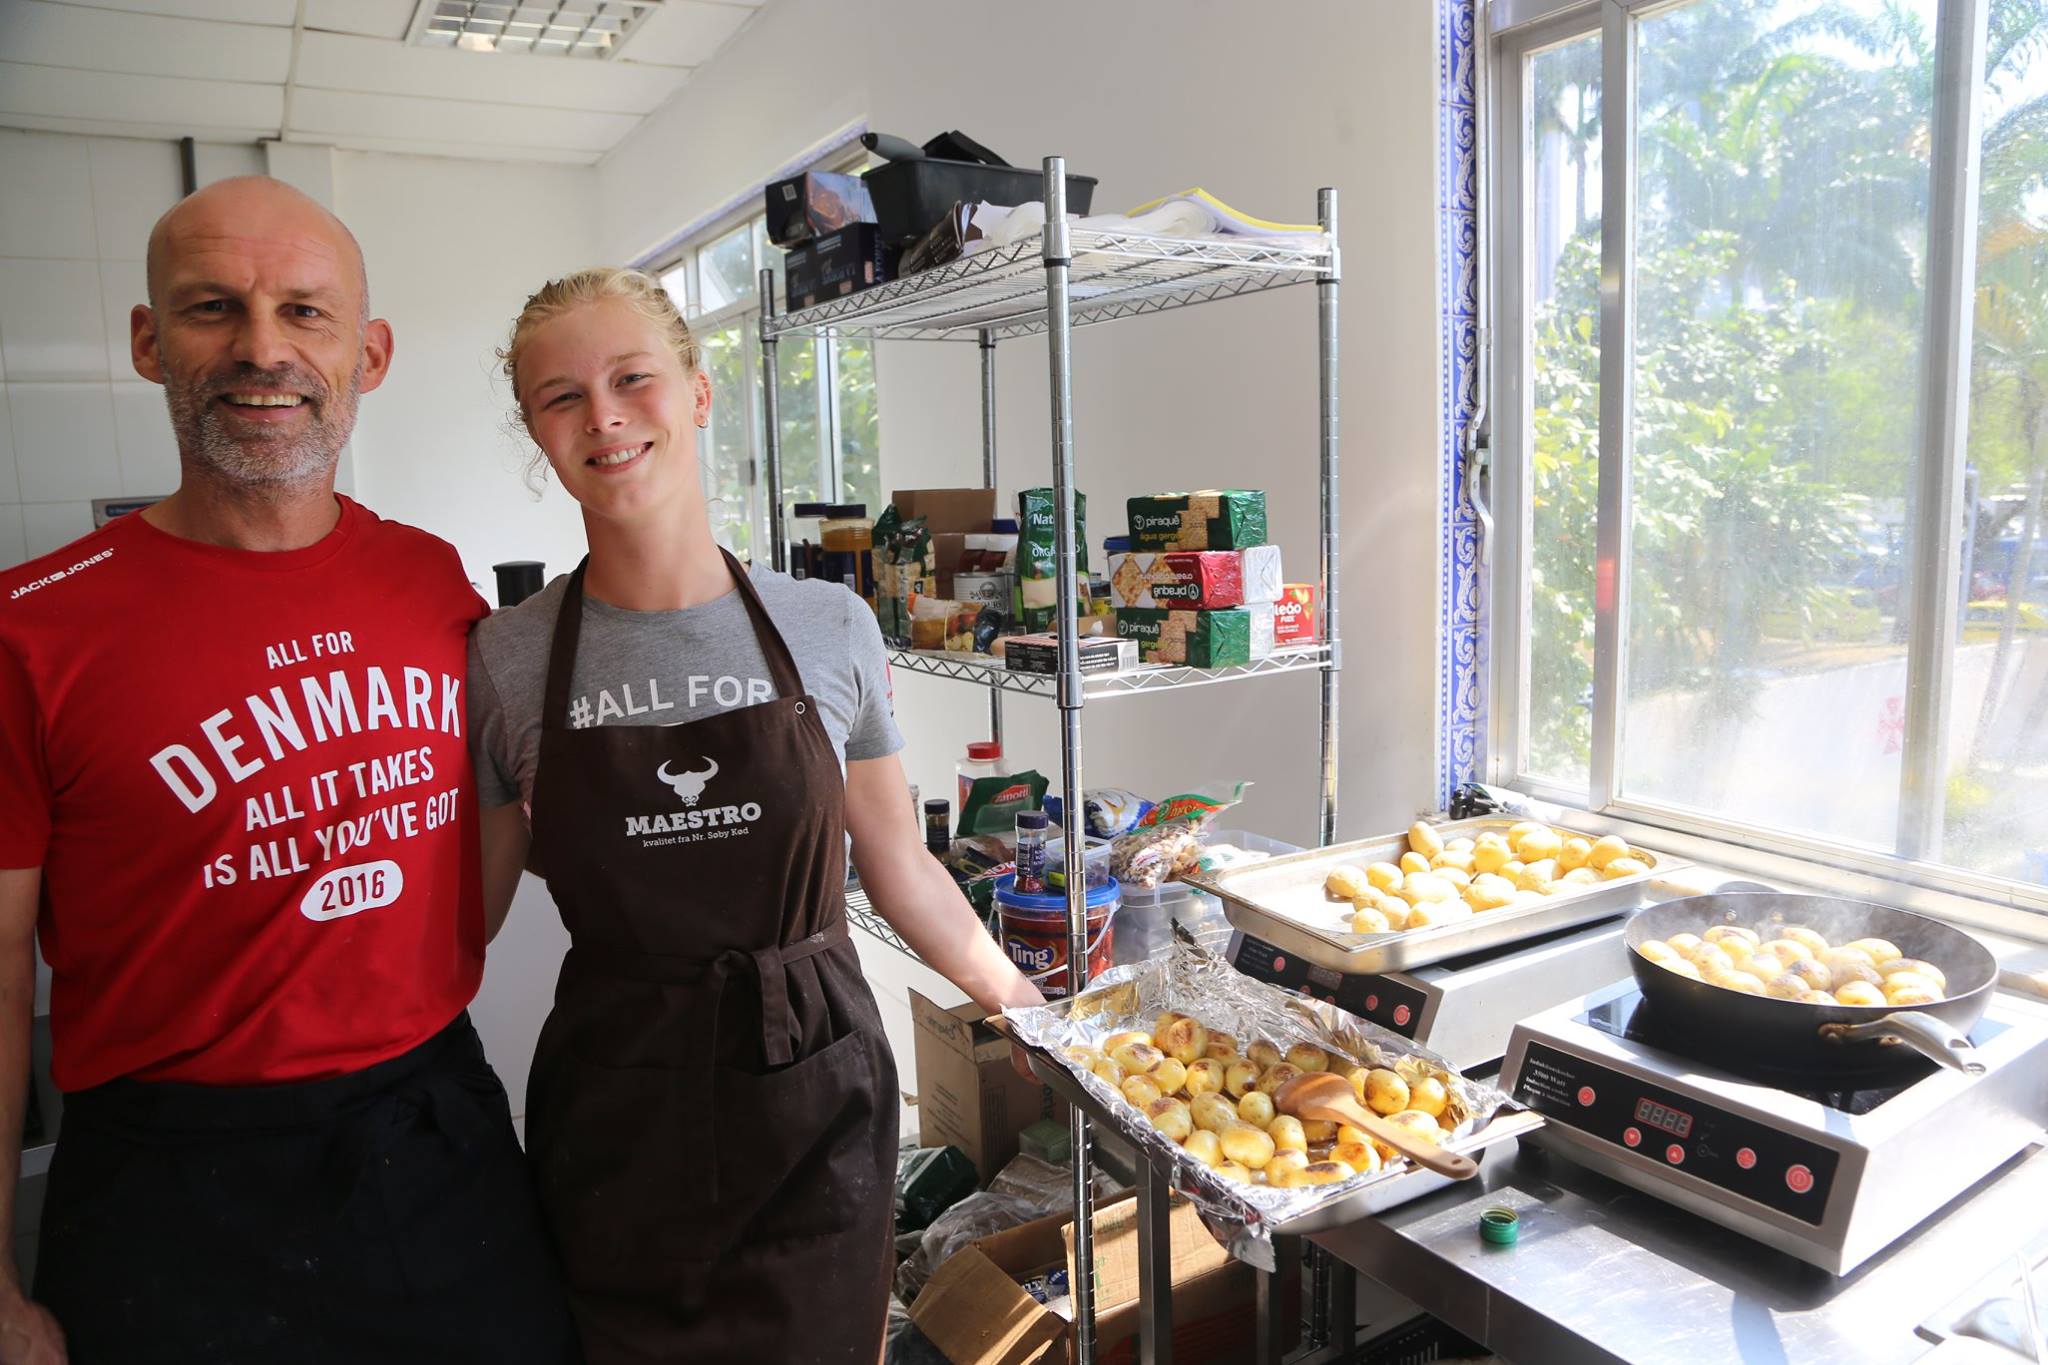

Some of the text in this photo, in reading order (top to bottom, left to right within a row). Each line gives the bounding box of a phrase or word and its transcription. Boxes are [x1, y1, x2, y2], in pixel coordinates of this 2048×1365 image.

[11, 549, 114, 600] JACK JONES
[266, 631, 355, 669] ALL FOR
[570, 675, 773, 729] #ALL FOR
[149, 666, 461, 814] DENMARK
[246, 746, 434, 832] ALL IT TAKES
[204, 788, 459, 888] IS ALL YOU'VE GOT
[625, 802, 762, 836] MAESTRO
[643, 826, 749, 848] kvalitet fra Nr. Søby Kød
[320, 869, 386, 912] 2016
[1008, 942, 1049, 970] Ting
